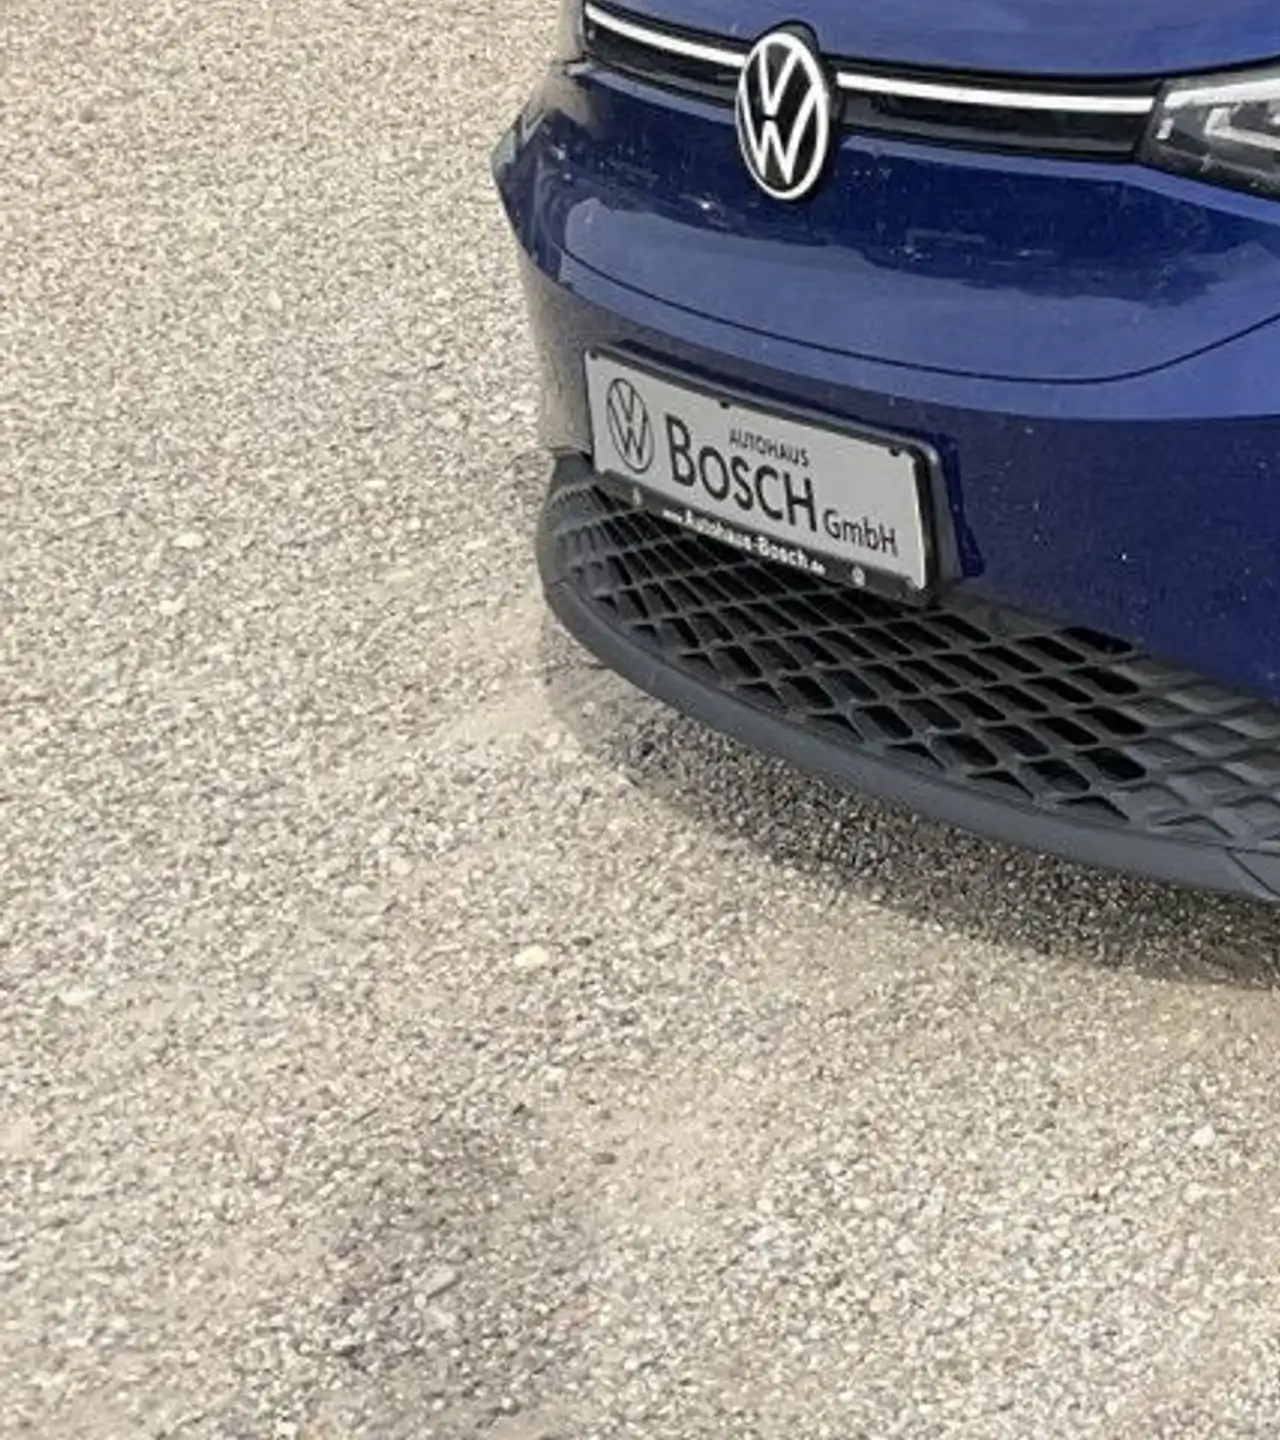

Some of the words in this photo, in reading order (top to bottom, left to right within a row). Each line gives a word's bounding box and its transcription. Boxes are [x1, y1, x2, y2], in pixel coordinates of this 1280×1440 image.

[664, 413, 818, 533] BOSCH
[823, 510, 899, 558] GmbH
[729, 428, 810, 468] AUTOHAUS
